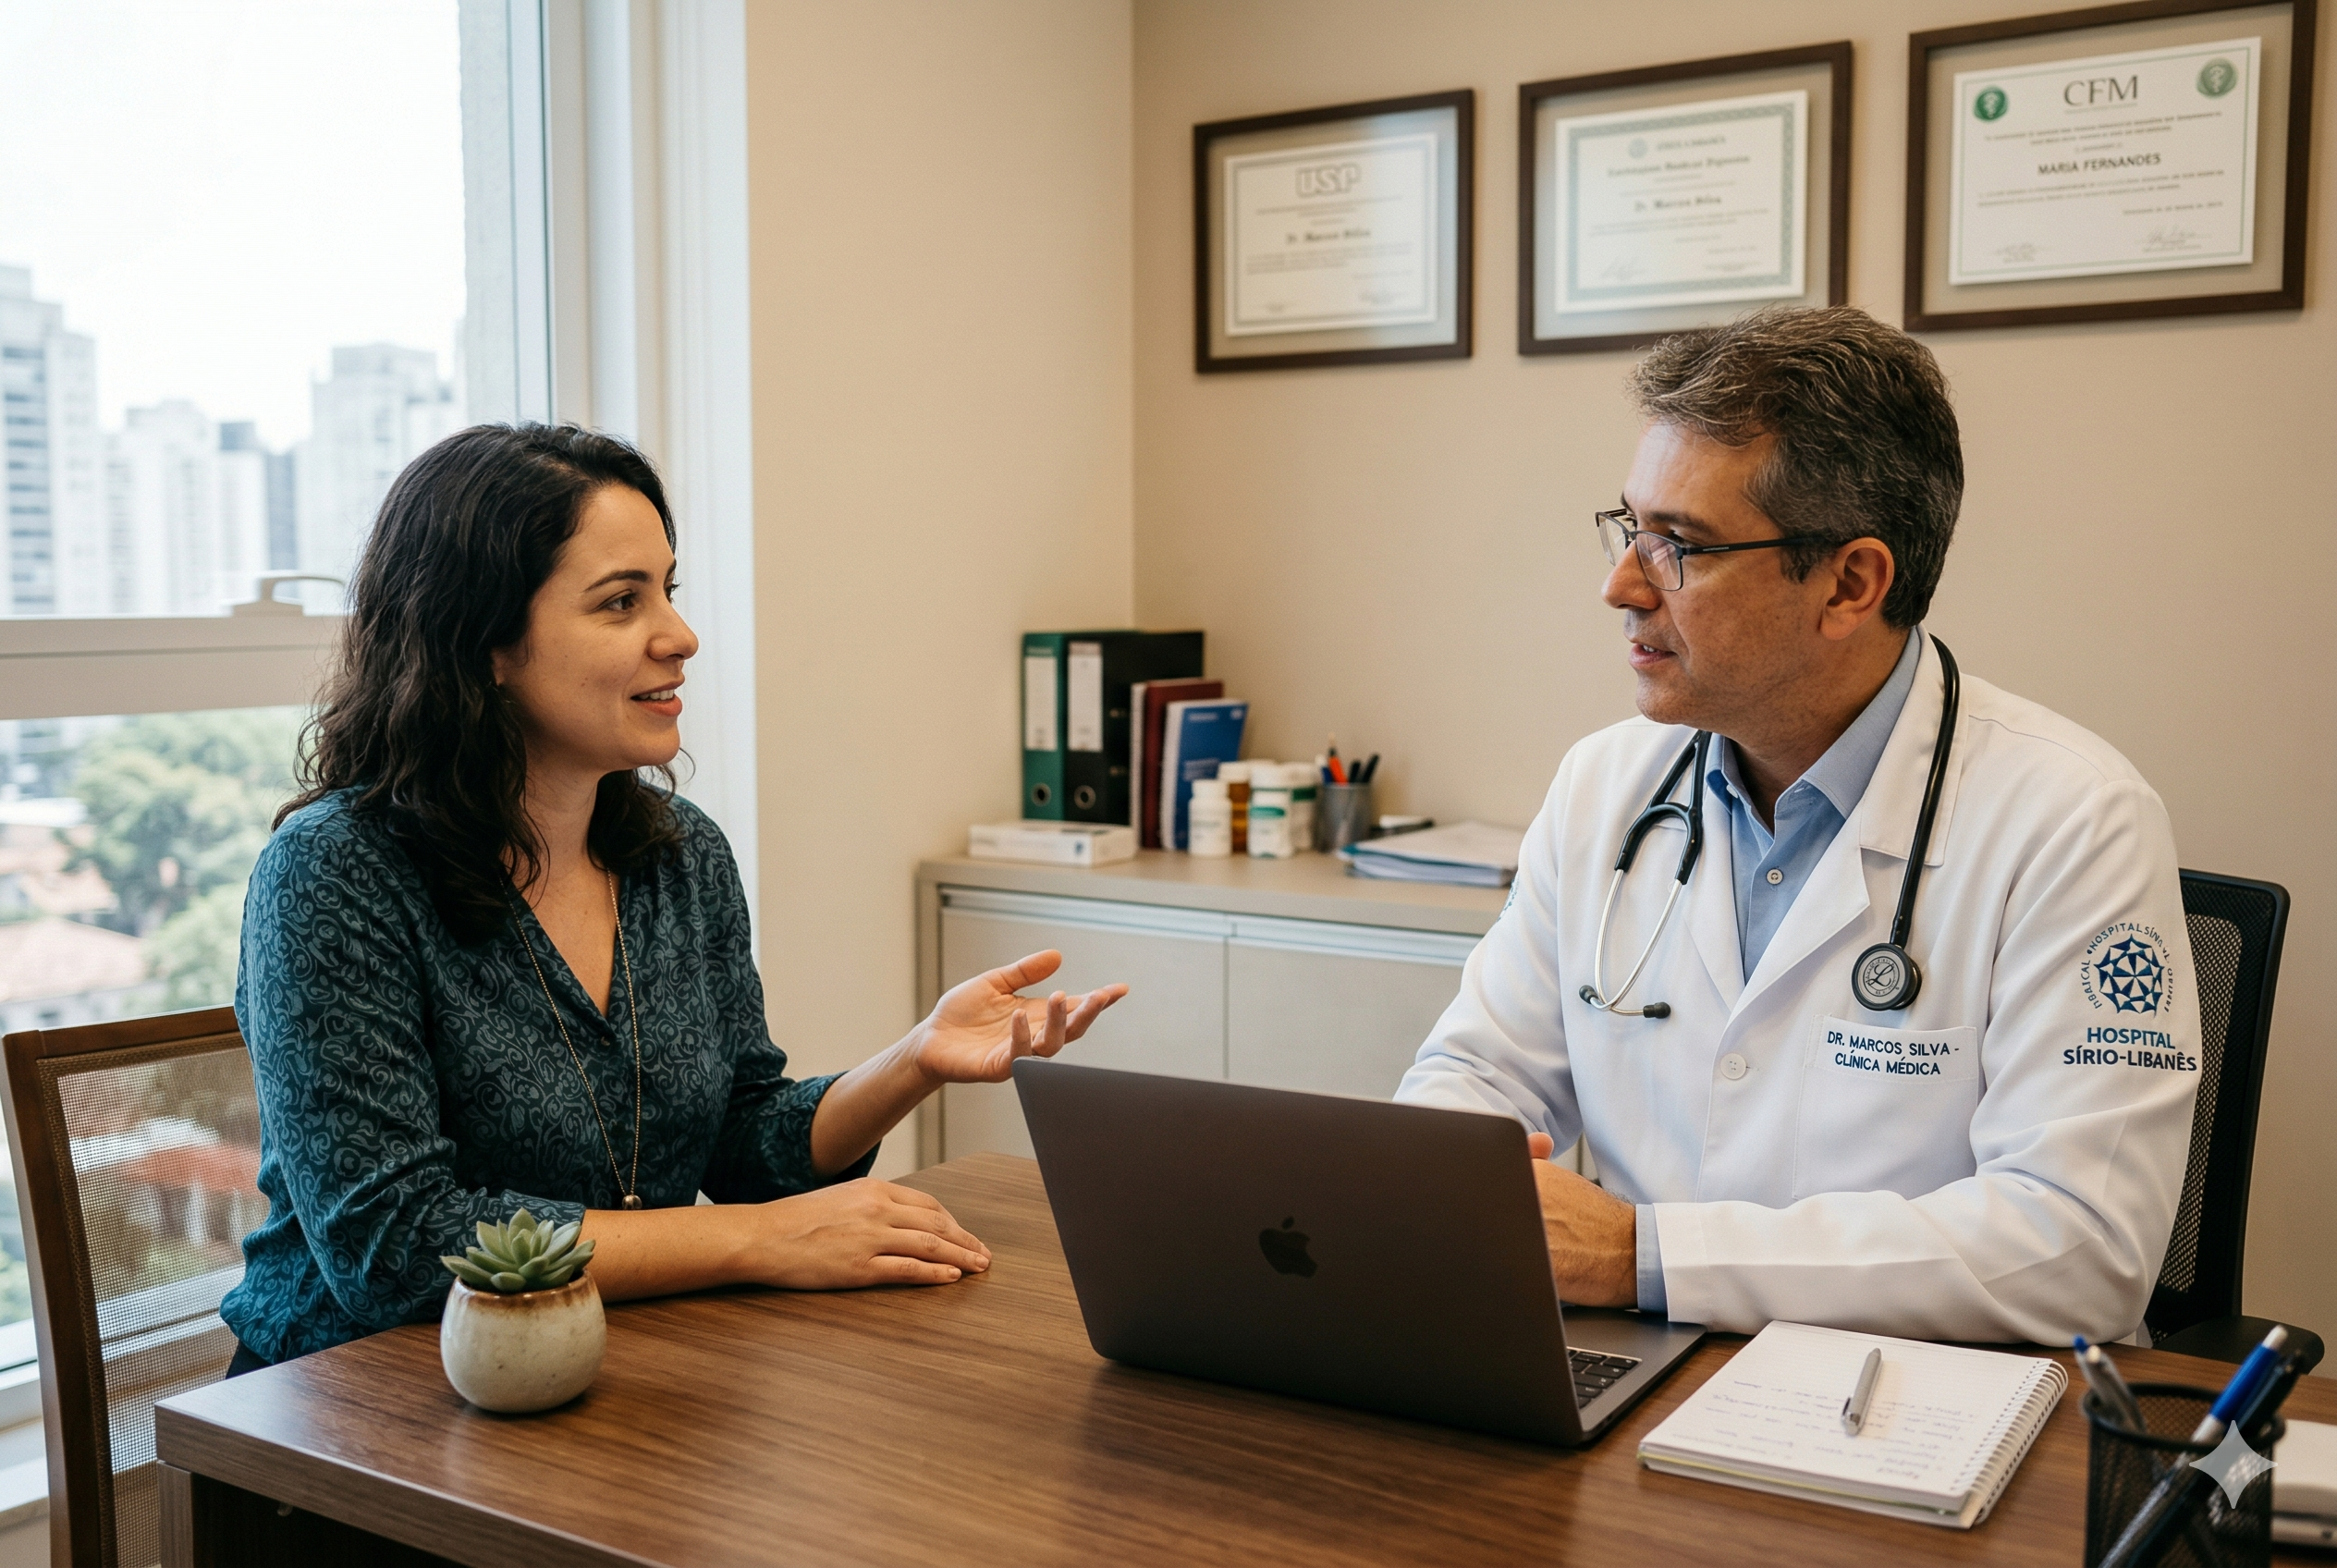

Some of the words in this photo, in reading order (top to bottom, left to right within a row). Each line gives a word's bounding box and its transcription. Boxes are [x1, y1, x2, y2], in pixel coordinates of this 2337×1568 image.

[2063, 76, 2138, 106] CFM
[2037, 161, 2079, 176] MARIA
[2083, 153, 2161, 170] FERNANDES
[1296, 162, 1362, 199] USP
[1827, 1031, 1845, 1047] DR.
[1849, 1035, 1903, 1055] MARCOS
[1909, 1043, 1951, 1057] SILVA
[2086, 1027, 2176, 1050] HOSPITAL
[1834, 1049, 1880, 1072] CLÍNICA
[1886, 1056, 1941, 1075] MÉDICA
[2062, 1045, 2197, 1072] SÍRIO-LIBANÊS
